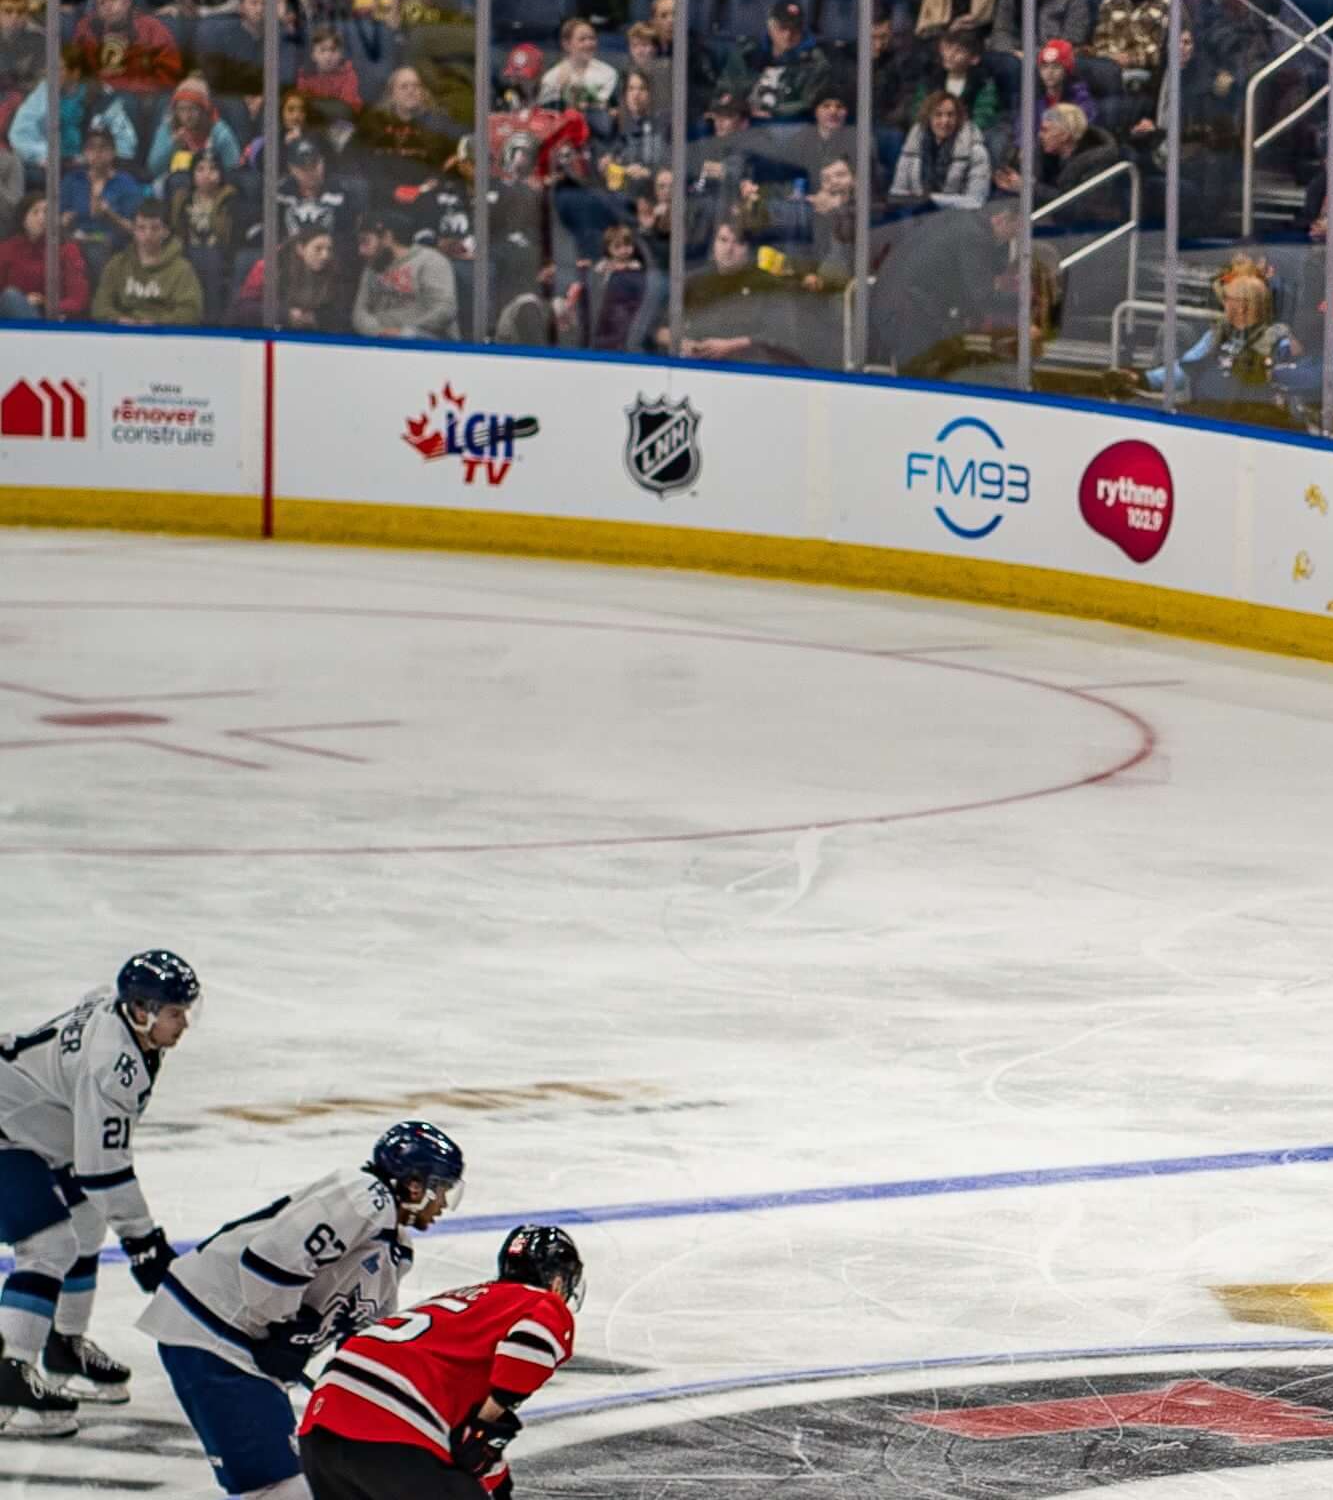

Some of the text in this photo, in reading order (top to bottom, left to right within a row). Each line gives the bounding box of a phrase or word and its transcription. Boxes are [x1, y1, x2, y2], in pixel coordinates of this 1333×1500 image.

[112, 425, 215, 447] construire
[446, 410, 515, 460] LCH
[640, 420, 688, 473] LNH
[461, 457, 512, 486] TV
[906, 452, 1031, 504] FM93
[1096, 476, 1168, 508] rythme
[1126, 506, 1163, 532] 102.9
[102, 1117, 131, 1150] 21
[303, 1222, 347, 1269] 67
